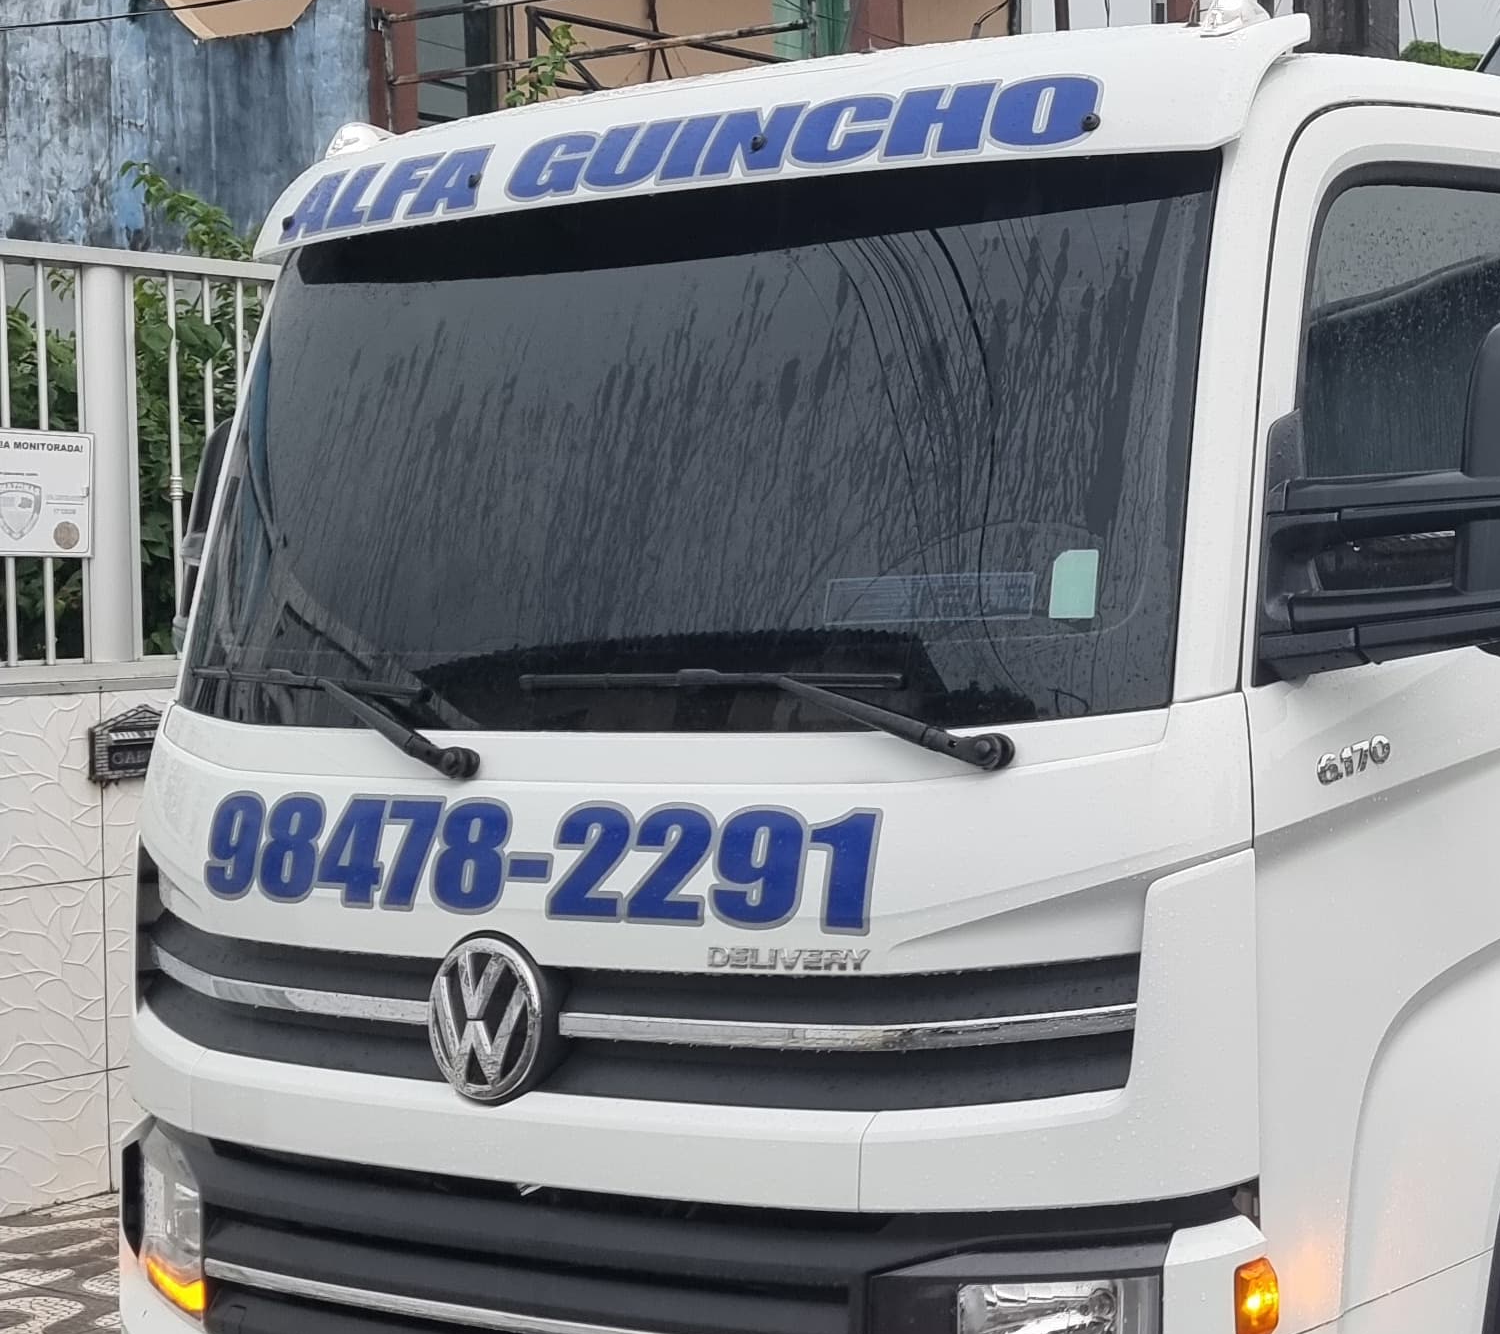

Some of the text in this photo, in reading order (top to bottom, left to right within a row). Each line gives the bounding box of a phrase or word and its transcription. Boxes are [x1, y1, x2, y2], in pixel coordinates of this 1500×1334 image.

[279, 74, 1104, 244] ALFA GUINCHO
[13, 441, 83, 453] MONITORADA!
[205, 791, 883, 935] 98478-2291
[707, 946, 871, 971] DELIVERY
